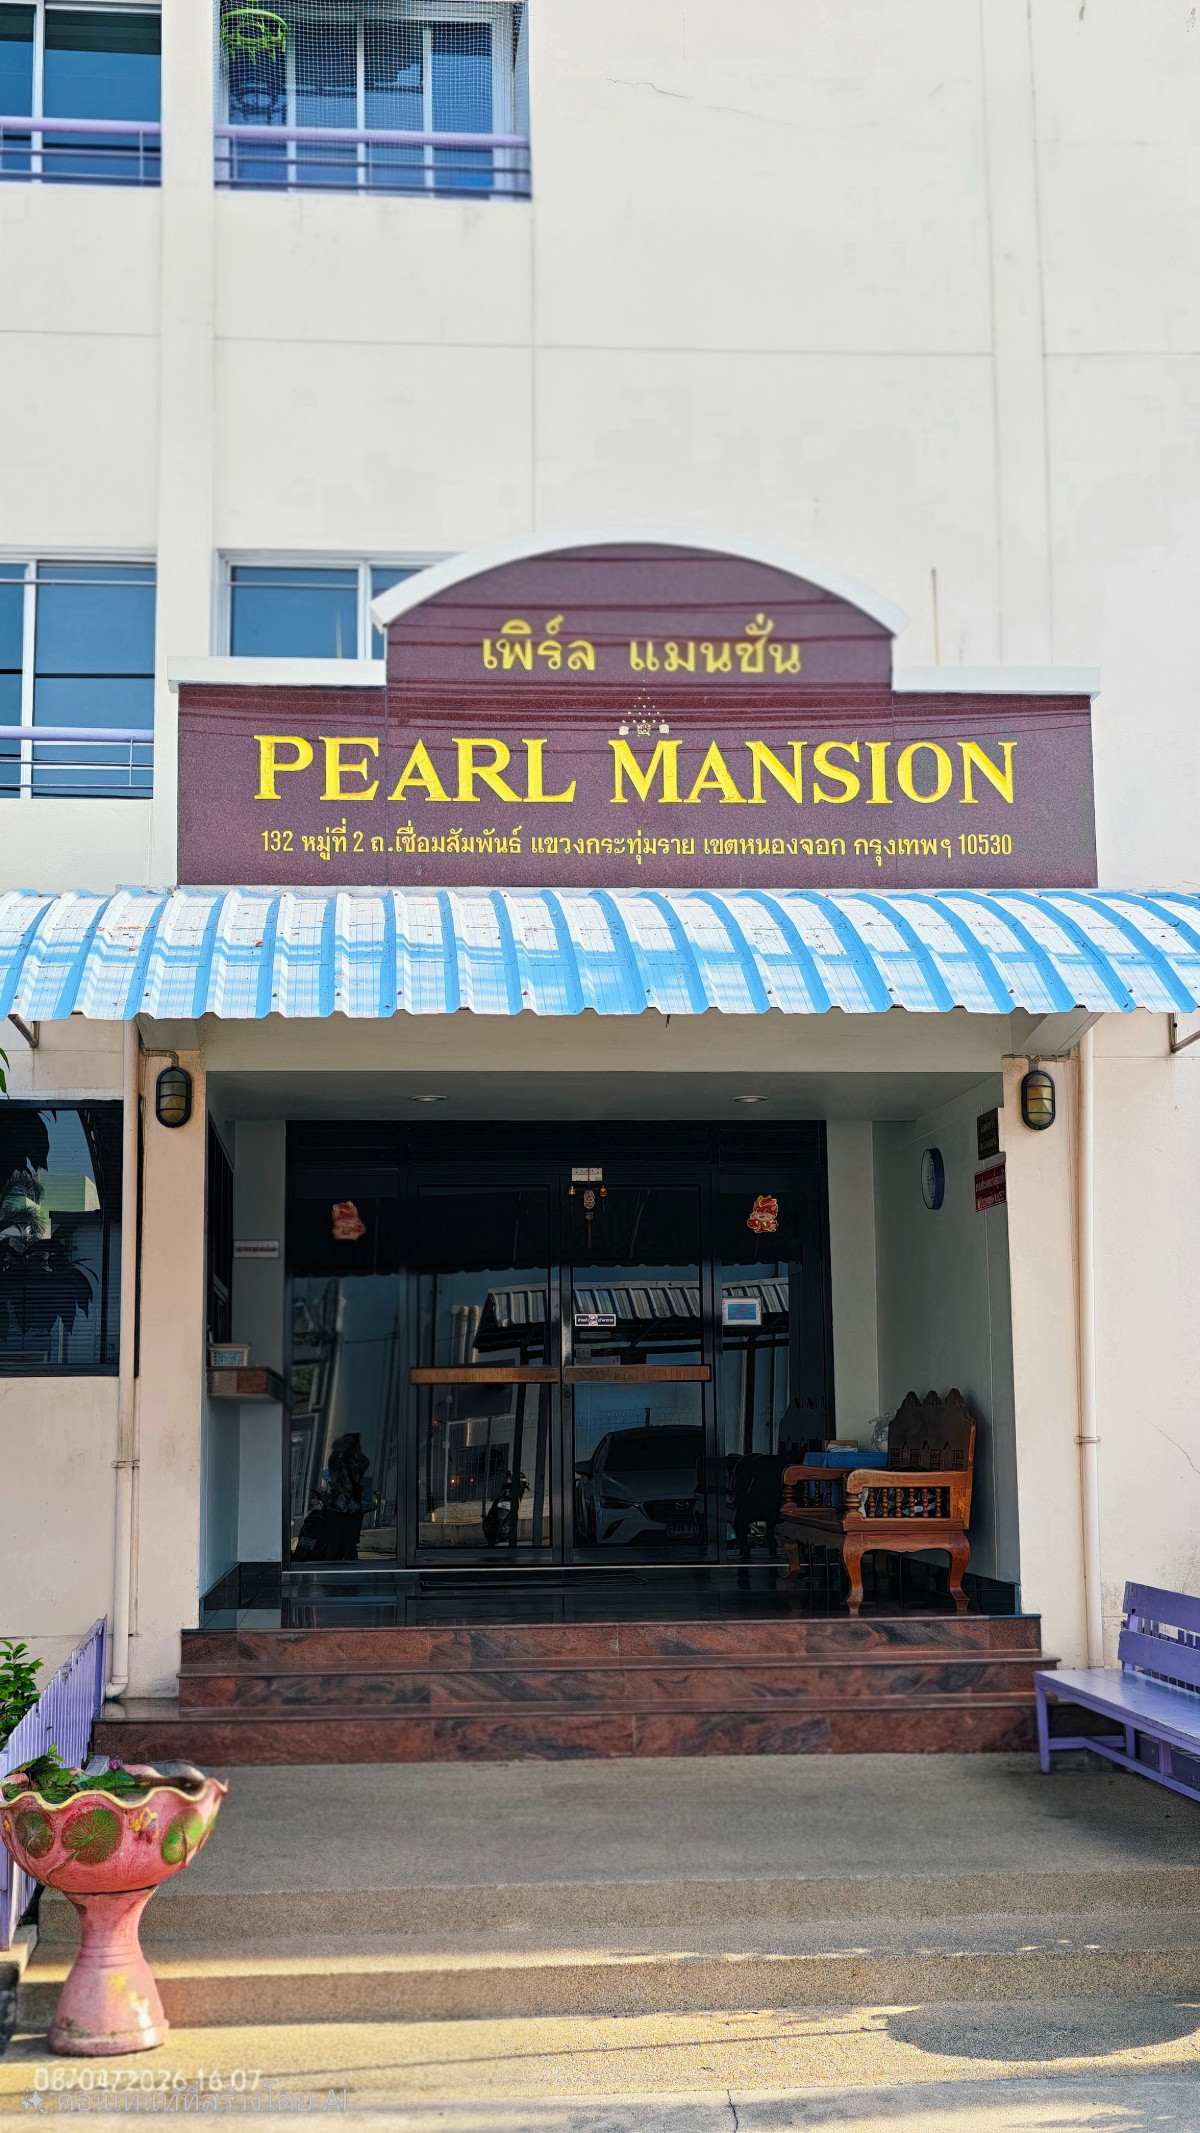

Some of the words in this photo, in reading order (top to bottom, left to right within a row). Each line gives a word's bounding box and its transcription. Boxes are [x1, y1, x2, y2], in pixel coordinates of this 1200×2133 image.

[482, 614, 595, 671] เพิร์ล
[629, 613, 801, 673] แมนชั่น
[254, 735, 577, 804] PEARL
[608, 739, 1017, 805] MANSION
[262, 830, 293, 852] 132
[301, 818, 347, 861] หมู่ที่
[353, 831, 364, 853] 2
[531, 830, 695, 865] แขวงกระทุ่มราย
[704, 836, 846, 856] เขตหนองจอก
[957, 833, 1014, 855] 10530
